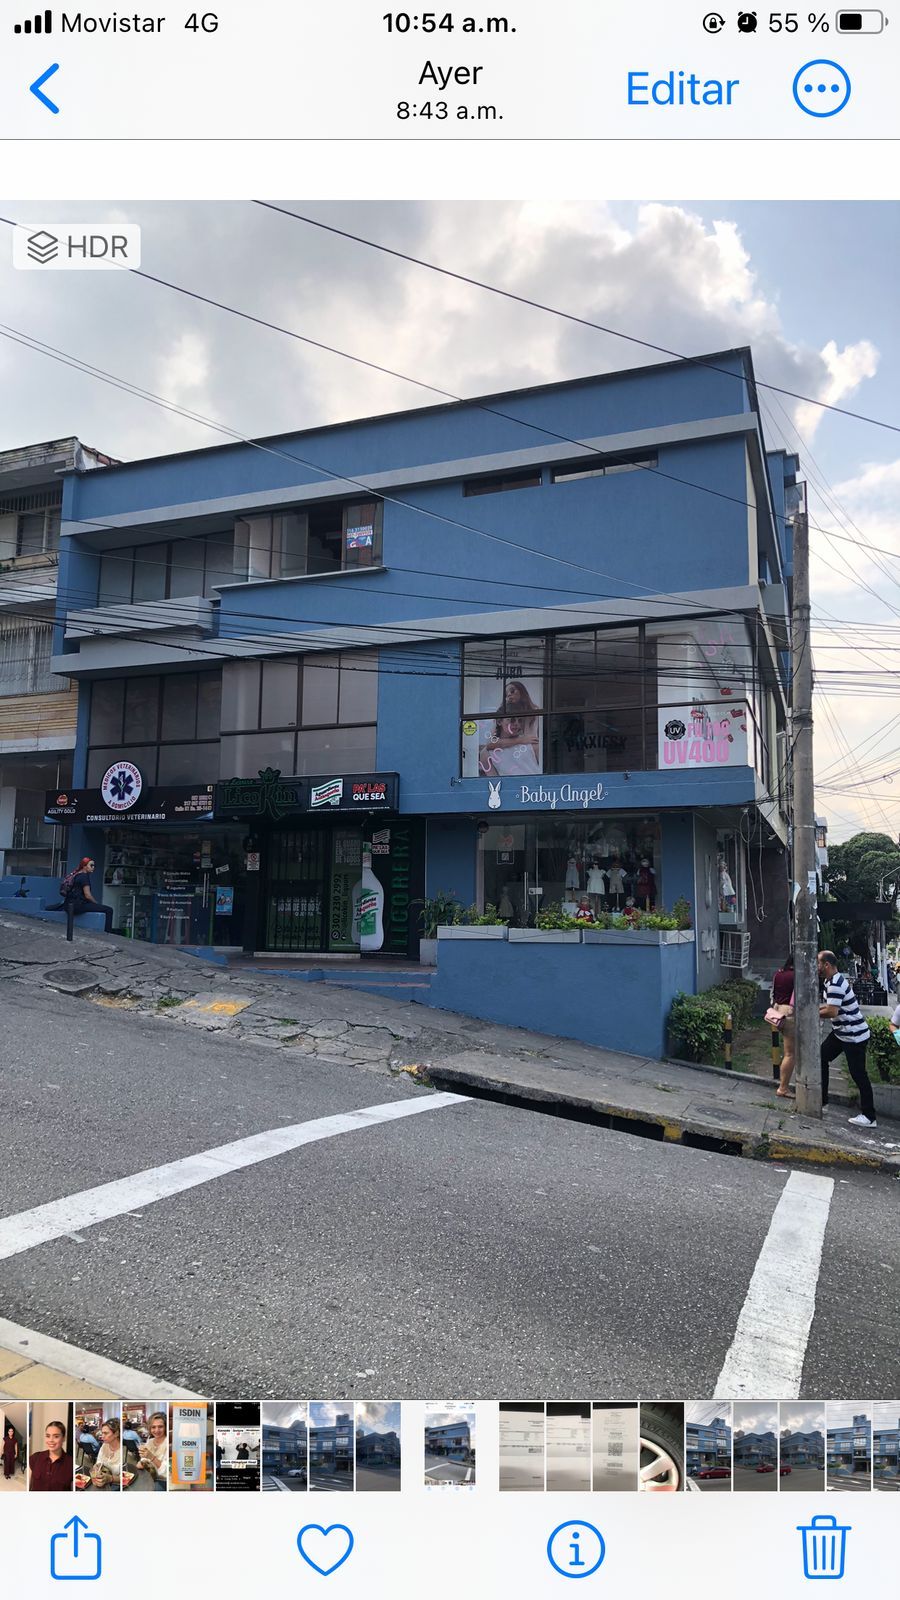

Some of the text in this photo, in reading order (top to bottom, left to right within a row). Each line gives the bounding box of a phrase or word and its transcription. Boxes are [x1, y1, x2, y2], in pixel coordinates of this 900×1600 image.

[62, 12, 218, 33] Movistar 4G
[383, 13, 517, 33] 10:54 a.m.
[769, 13, 830, 33] 55 %
[418, 61, 484, 91] Ayer
[628, 71, 740, 106] Editar
[397, 101, 504, 120] 8:43 a.m.
[67, 235, 129, 258] HDR
[669, 726, 681, 735] UV
[663, 740, 730, 765] UV400
[353, 792, 386, 801] QUE SEA
[367, 783, 386, 792] LAS
[520, 782, 605, 809] Baby Angel
[126, 813, 166, 821] VETERINARIO
[180, 1408, 201, 1418] ISDIN
